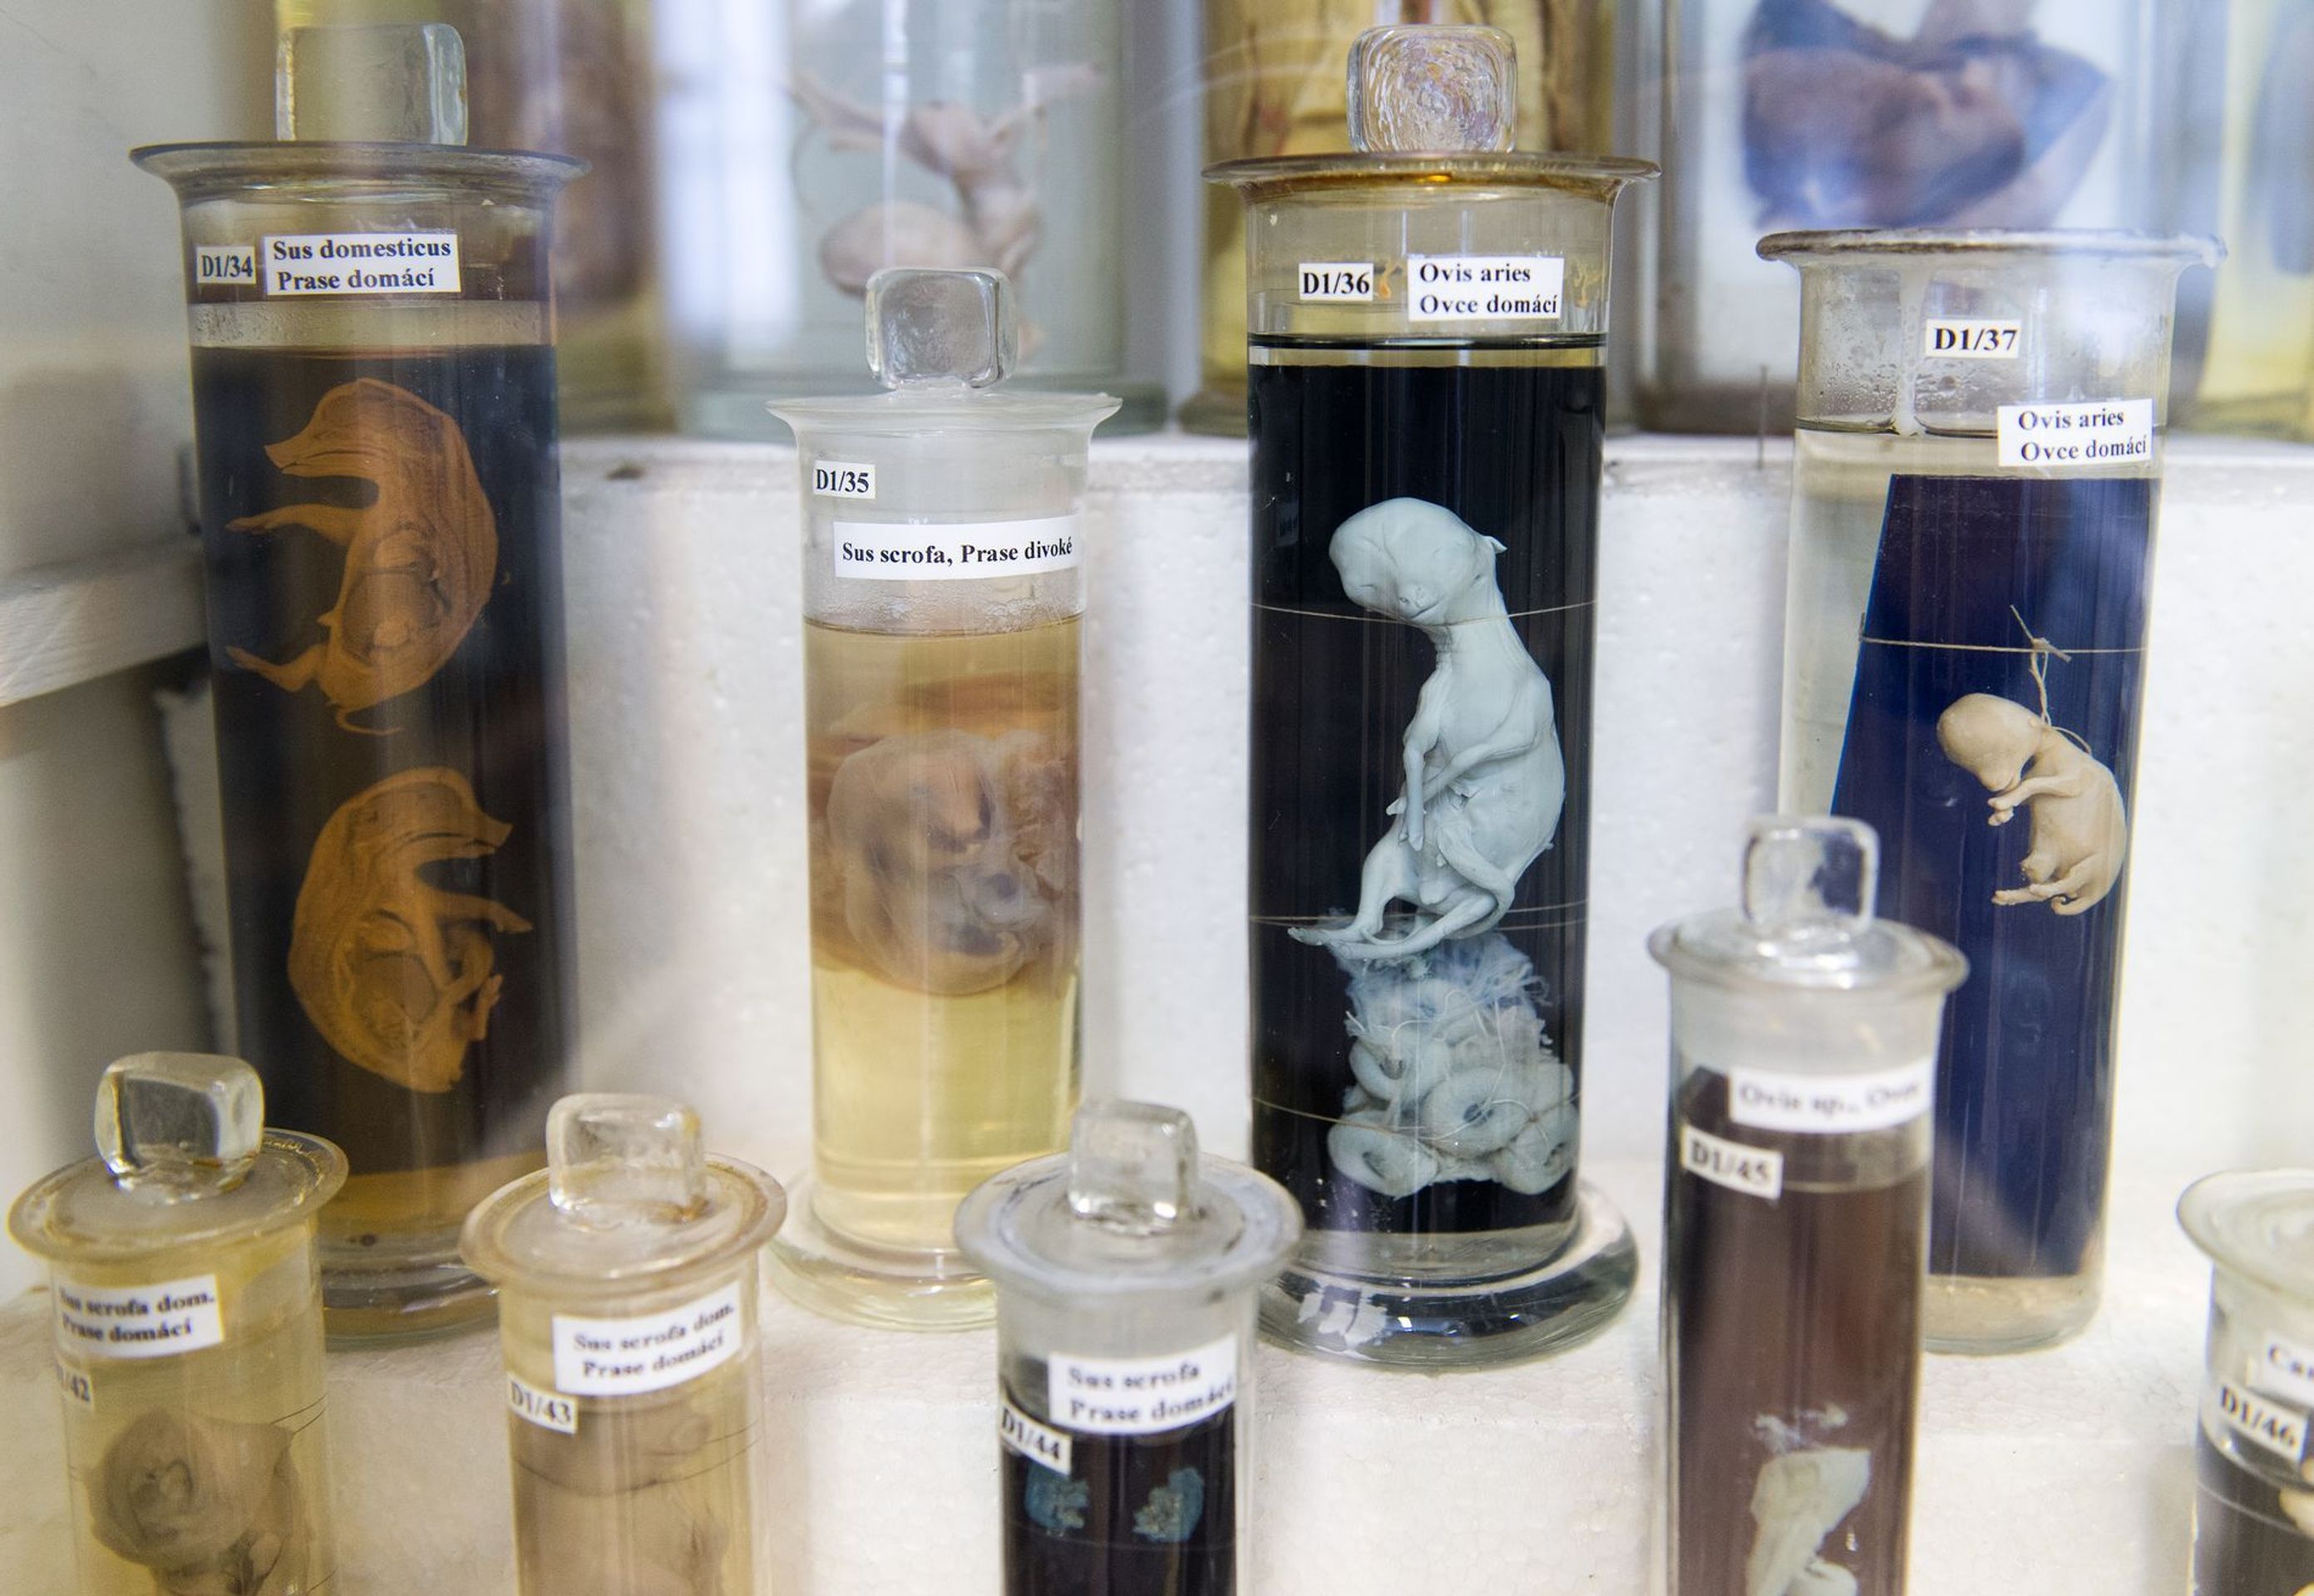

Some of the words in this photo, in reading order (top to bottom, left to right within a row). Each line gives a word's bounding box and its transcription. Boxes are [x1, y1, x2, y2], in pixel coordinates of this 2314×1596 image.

[273, 240, 313, 260] Sus
[320, 239, 451, 259] domesticus
[201, 254, 254, 278] D1/34
[277, 271, 340, 291] Prase
[348, 267, 435, 288] domácí
[1419, 263, 1473, 283] Ovis
[1480, 264, 1531, 282] aries
[1302, 272, 1370, 294] D1/36
[1419, 294, 1478, 314] Ovce
[1486, 293, 1558, 313] domácí
[1934, 327, 2018, 352] D1/37
[2018, 410, 2071, 431] Ovis
[2078, 408, 2124, 428] aries
[2020, 441, 2080, 461] Ovce
[2085, 435, 2147, 459] domácí
[816, 468, 870, 493] D1/35
[841, 541, 874, 563] Sus
[880, 544, 953, 567] scrofa,
[960, 543, 1019, 564] Prase
[1024, 536, 1073, 560] divoké
[1691, 1139, 1769, 1187] D1/45
[86, 1298, 149, 1317] scrofa
[156, 1290, 215, 1313] dom.
[109, 1316, 193, 1342] domácí
[573, 1332, 612, 1352] Sus
[619, 1324, 688, 1350] scrofa
[693, 1302, 734, 1332] dom.
[583, 1360, 644, 1377] Prase
[652, 1329, 724, 1372] domácí
[1068, 1367, 1113, 1388] Sus
[1122, 1361, 1200, 1390] scrofa
[511, 1380, 571, 1426] D1/43
[1069, 1398, 1140, 1422] Prase
[2221, 1385, 2297, 1448] D1/46
[1001, 1406, 1060, 1461] D1/44
